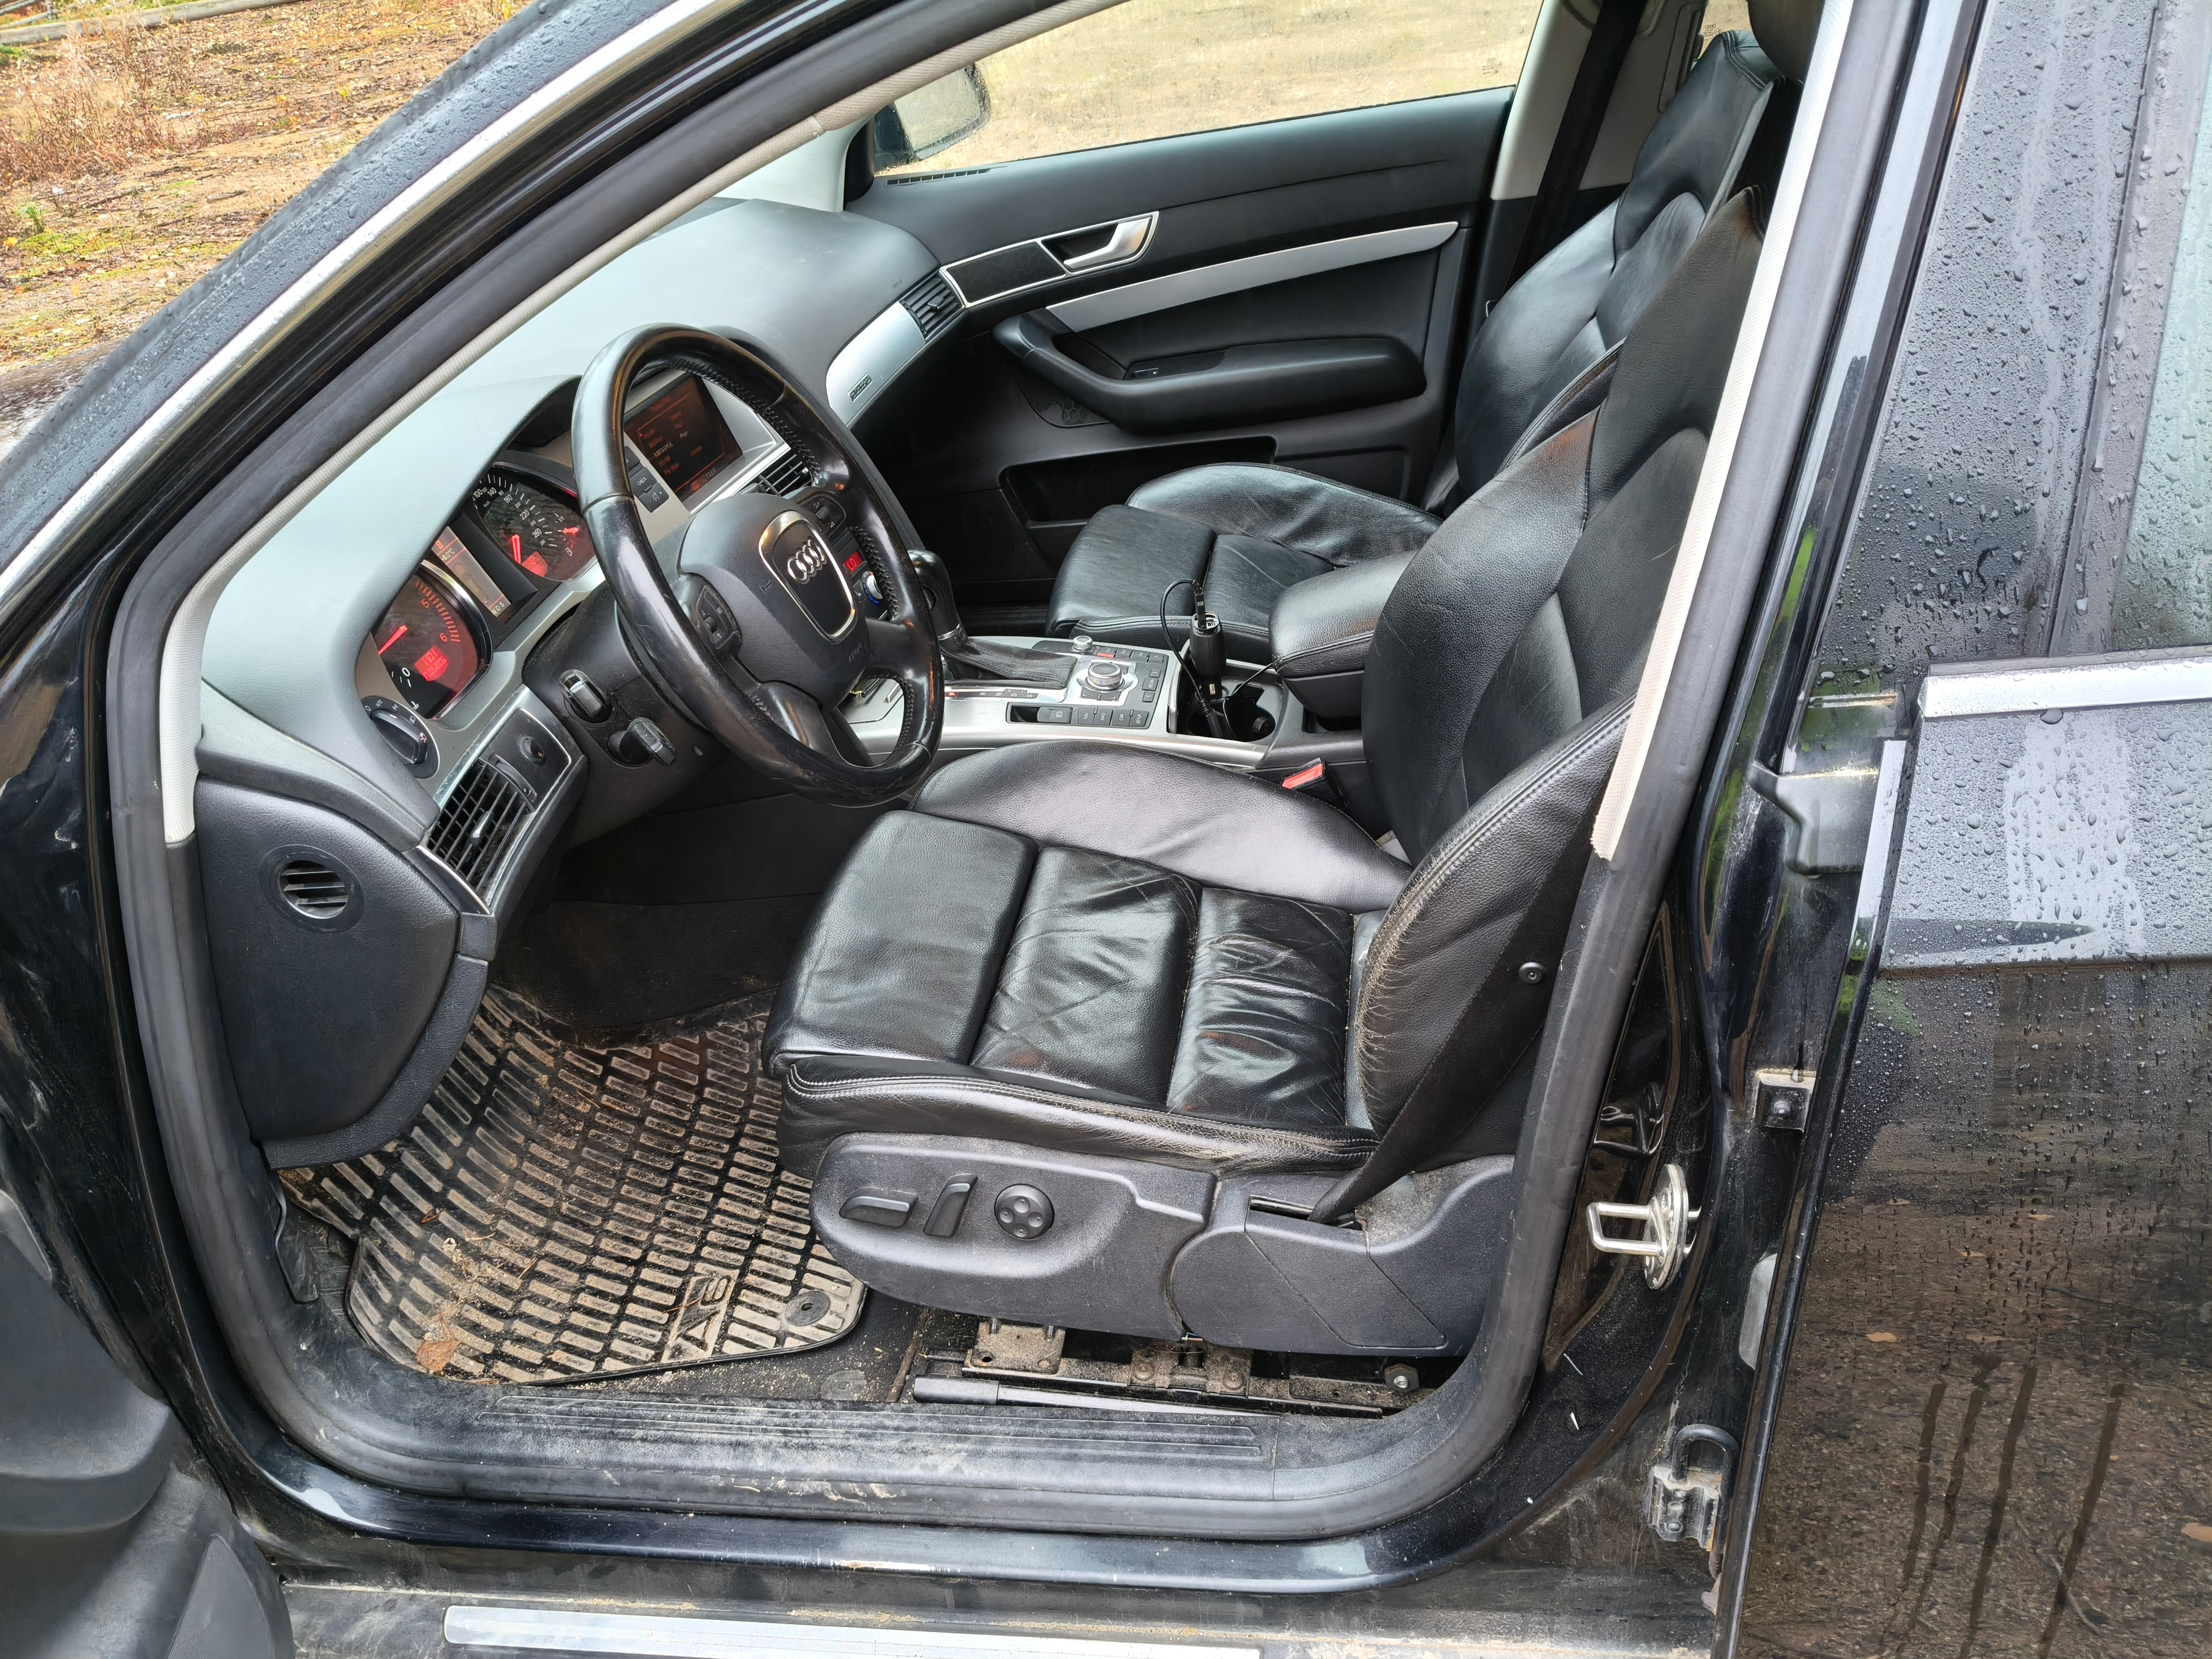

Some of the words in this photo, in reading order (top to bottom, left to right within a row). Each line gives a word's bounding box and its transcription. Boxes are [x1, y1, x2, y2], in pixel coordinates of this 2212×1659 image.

[637, 477, 647, 486] CHECK
[474, 488, 483, 498] 100
[487, 487, 497, 497] 140
[503, 494, 513, 504] 180
[520, 509, 529, 520] 220
[532, 528, 542, 538] 260
[420, 598, 430, 610] 5
[439, 632, 448, 643] 6
[401, 667, 410, 677] 0
